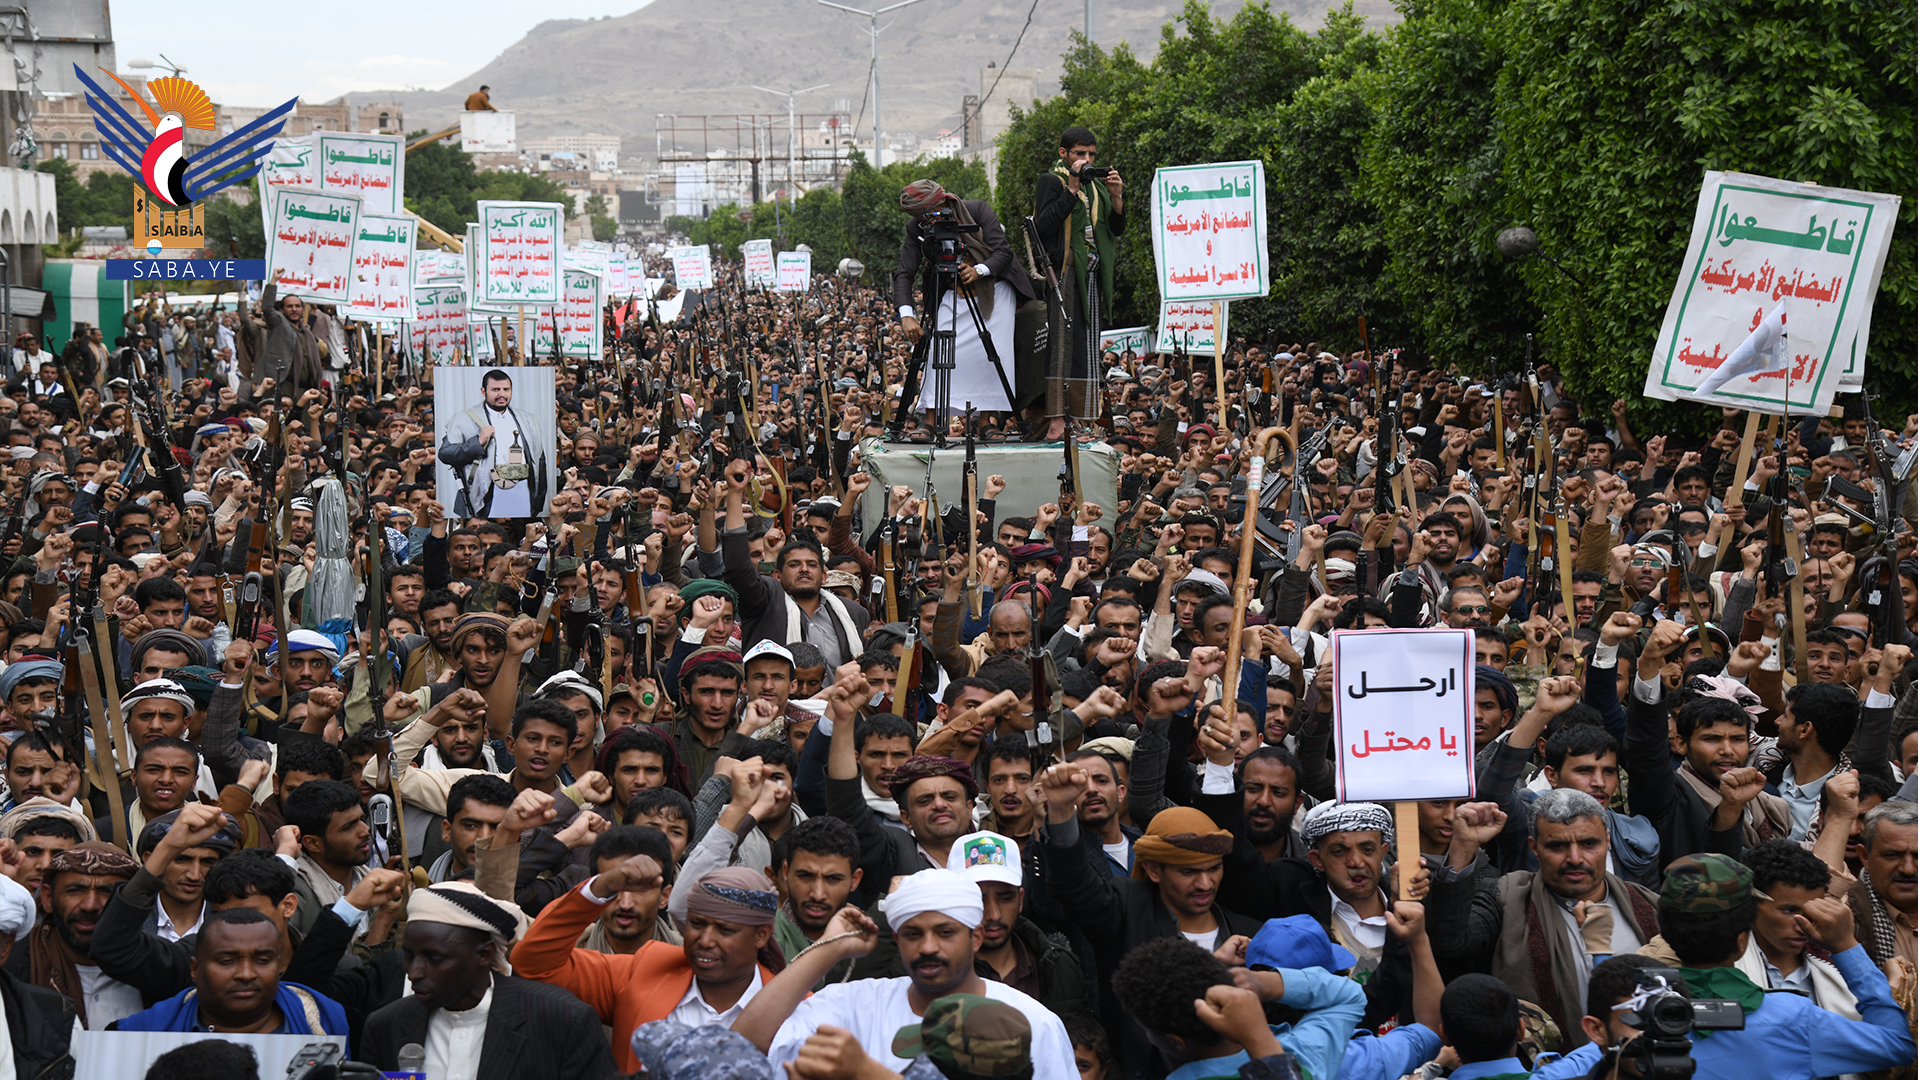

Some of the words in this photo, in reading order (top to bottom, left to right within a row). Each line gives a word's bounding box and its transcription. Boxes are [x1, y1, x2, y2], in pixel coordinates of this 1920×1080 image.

[325, 145, 392, 166] قاطعوا
[325, 170, 360, 187] الأمريكية
[360, 172, 391, 190] البضائع
[1164, 175, 1251, 208] قاطعوا
[284, 198, 352, 223] قاطعوا
[490, 210, 527, 231] أكبر
[530, 213, 553, 228] الله
[1166, 209, 1211, 236] الأمريكية
[1213, 211, 1252, 234] البضائع
[1716, 202, 1858, 255] قاطعوا
[277, 225, 317, 246] الأمريكية
[317, 230, 350, 250] البضائع
[359, 225, 407, 244] قاطع
[490, 231, 522, 245] لأمريكا
[525, 235, 553, 246] الموت
[490, 249, 522, 262] لإسرائيل
[1206, 239, 1212, 256] و
[307, 252, 314, 265] و
[381, 252, 408, 270] البضائع
[525, 251, 553, 262] الموت
[374, 273, 380, 286] و
[490, 266, 513, 277] اليهود
[516, 265, 529, 278] على
[532, 266, 553, 276] اللعنة
[1169, 261, 1255, 288] الإسرائيلية
[1700, 258, 1775, 295] الأمريكية
[525, 280, 553, 297] النصر
[573, 276, 594, 289] الله
[1772, 267, 1843, 307] البضائع
[352, 293, 409, 312] الإسرائيلي
[415, 289, 441, 310] أكب
[444, 291, 465, 304] الله
[569, 295, 594, 305] الموت
[417, 308, 439, 321] لأمريك
[442, 309, 466, 319] الموت
[569, 309, 594, 319] الموت
[575, 322, 594, 332] اللعنة
[1348, 668, 1455, 699] ارحل
[1351, 730, 1431, 758] محتل
[1439, 727, 1458, 757] يا
